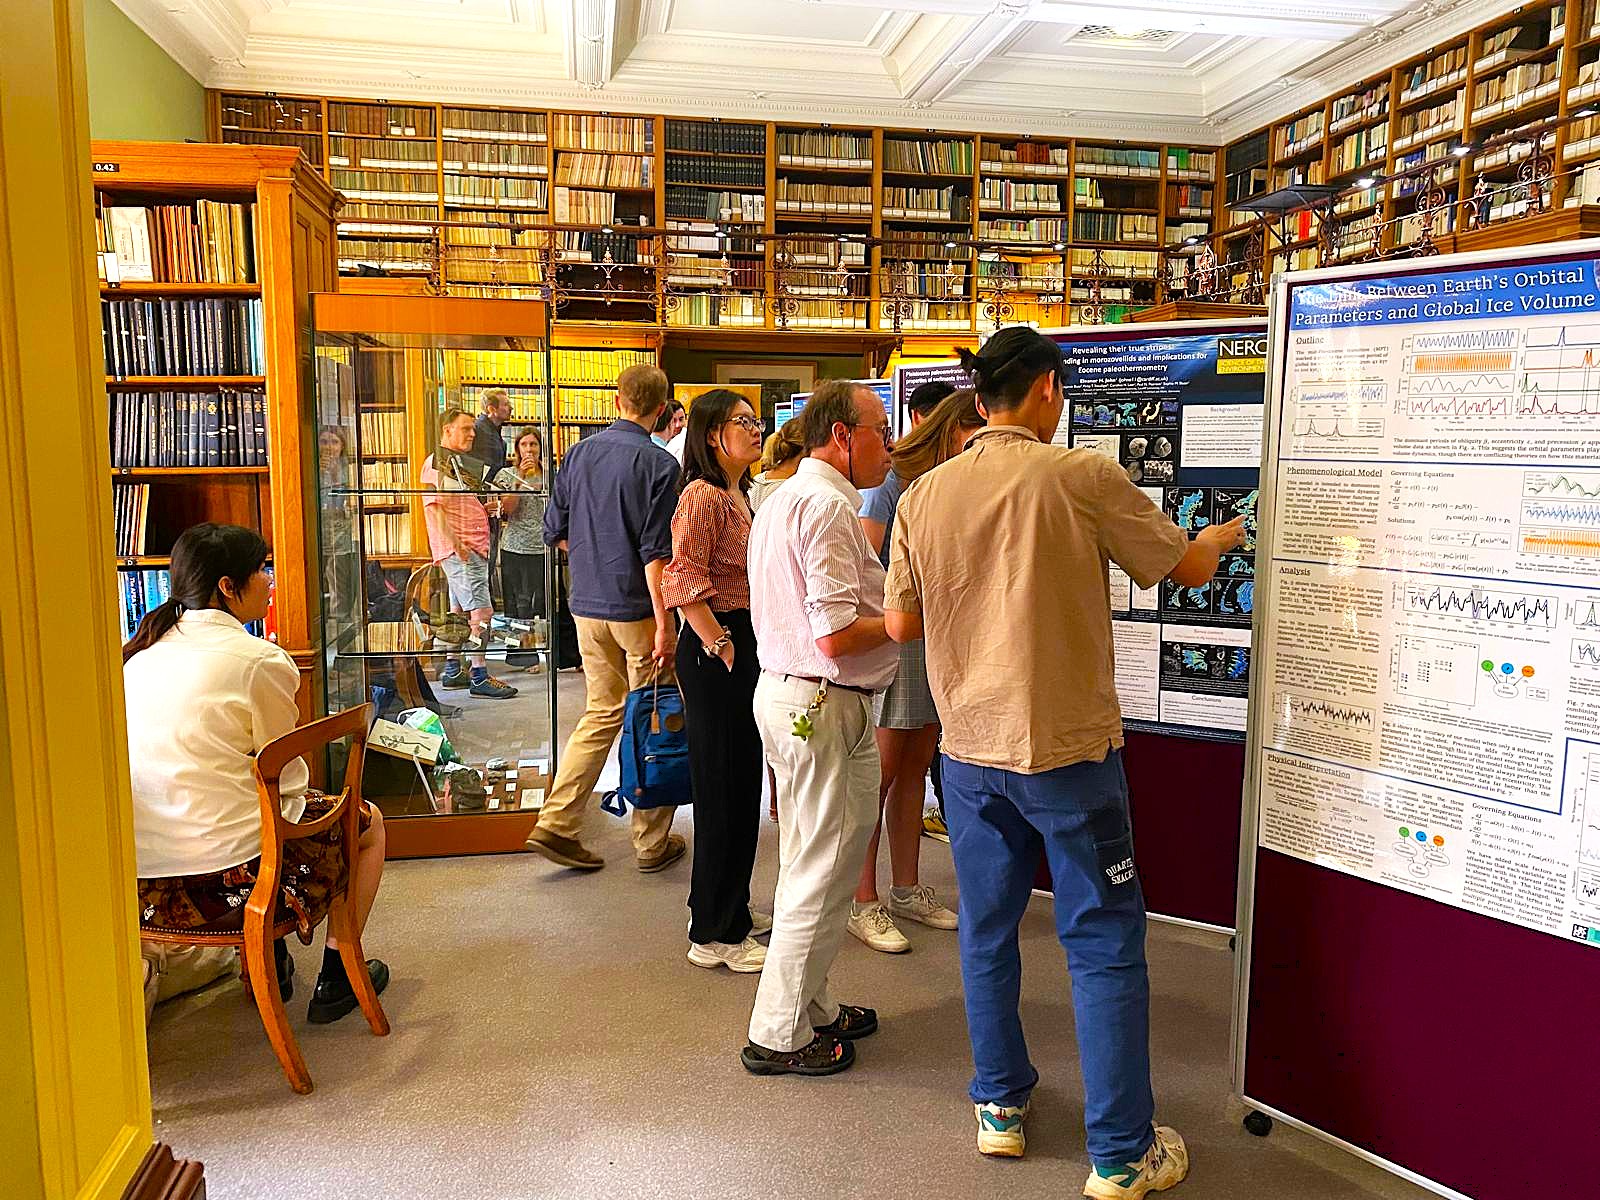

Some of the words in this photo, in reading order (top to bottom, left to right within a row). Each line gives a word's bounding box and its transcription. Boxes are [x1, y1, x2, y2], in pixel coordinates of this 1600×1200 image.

[1366, 283, 1437, 298] Between
[1443, 275, 1508, 293] Earth's
[1514, 267, 1584, 288] Orbital
[1295, 309, 1382, 326] Parameters
[1388, 304, 1418, 320] and
[1424, 299, 1480, 317] Global
[1486, 298, 1514, 312] Ice
[1520, 294, 1595, 310] Volume
[1296, 336, 1324, 345] Outline
[1220, 340, 1267, 356] NERC
[1103, 364, 1168, 374] paleothermometry
[1287, 467, 1356, 476] Phenomenological
[1358, 468, 1382, 477] Model
[1390, 470, 1422, 478] Governing
[1279, 566, 1311, 576] Analysis
[1566, 707, 1598, 716] combining
[1517, 747, 1535, 755] subset
[1475, 752, 1503, 762] significant
[1504, 759, 1525, 767] enough
[1534, 763, 1553, 772] justify
[1519, 754, 1539, 762] around
[1268, 754, 1297, 767] Physical
[1298, 760, 1351, 779] Interpretation
[1475, 771, 1493, 779] change
[1517, 774, 1540, 782] perform
[1472, 802, 1506, 816] Governing
[1508, 812, 1542, 824] Equations
[1532, 866, 1552, 875] factors
[1519, 875, 1541, 884] relevant
[1464, 886, 1512, 903] phenomenological
[1514, 899, 1529, 908] likely
[1516, 915, 1543, 925] dynamics
